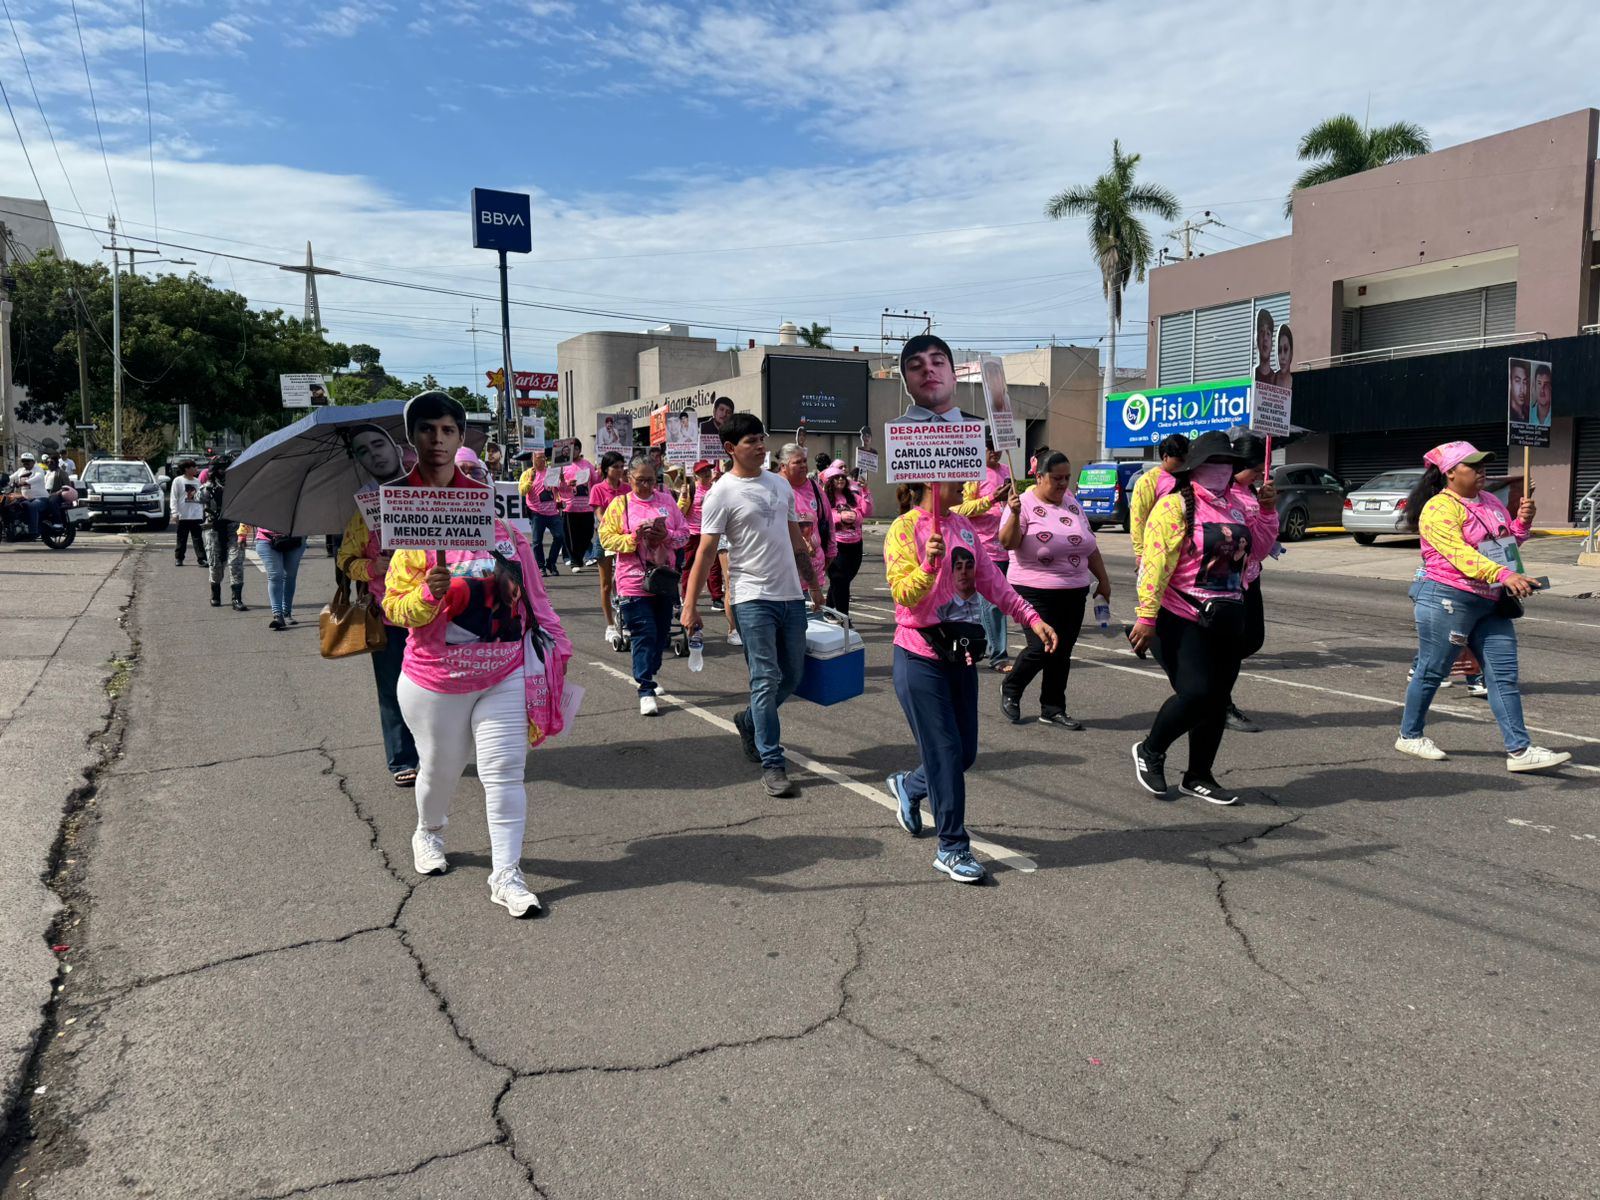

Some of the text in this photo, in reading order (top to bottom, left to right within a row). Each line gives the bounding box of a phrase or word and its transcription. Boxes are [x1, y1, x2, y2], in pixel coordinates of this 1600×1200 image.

[481, 210, 525, 226] BBVA
[1152, 387, 1250, 422] FisioVital
[890, 424, 982, 434] DESAPARECIDO
[895, 446, 978, 458] CARLOS ALFONSO
[891, 459, 982, 470] CASTILLO PACHECO
[894, 472, 935, 481] ¡ESPERAMOS
[384, 489, 489, 500] DESAPARECIDO
[383, 513, 492, 526] RICARDO ALEXANDER
[393, 527, 482, 538] MENDEZ AYALA
[389, 538, 436, 547] ¡ESPERAMOS
